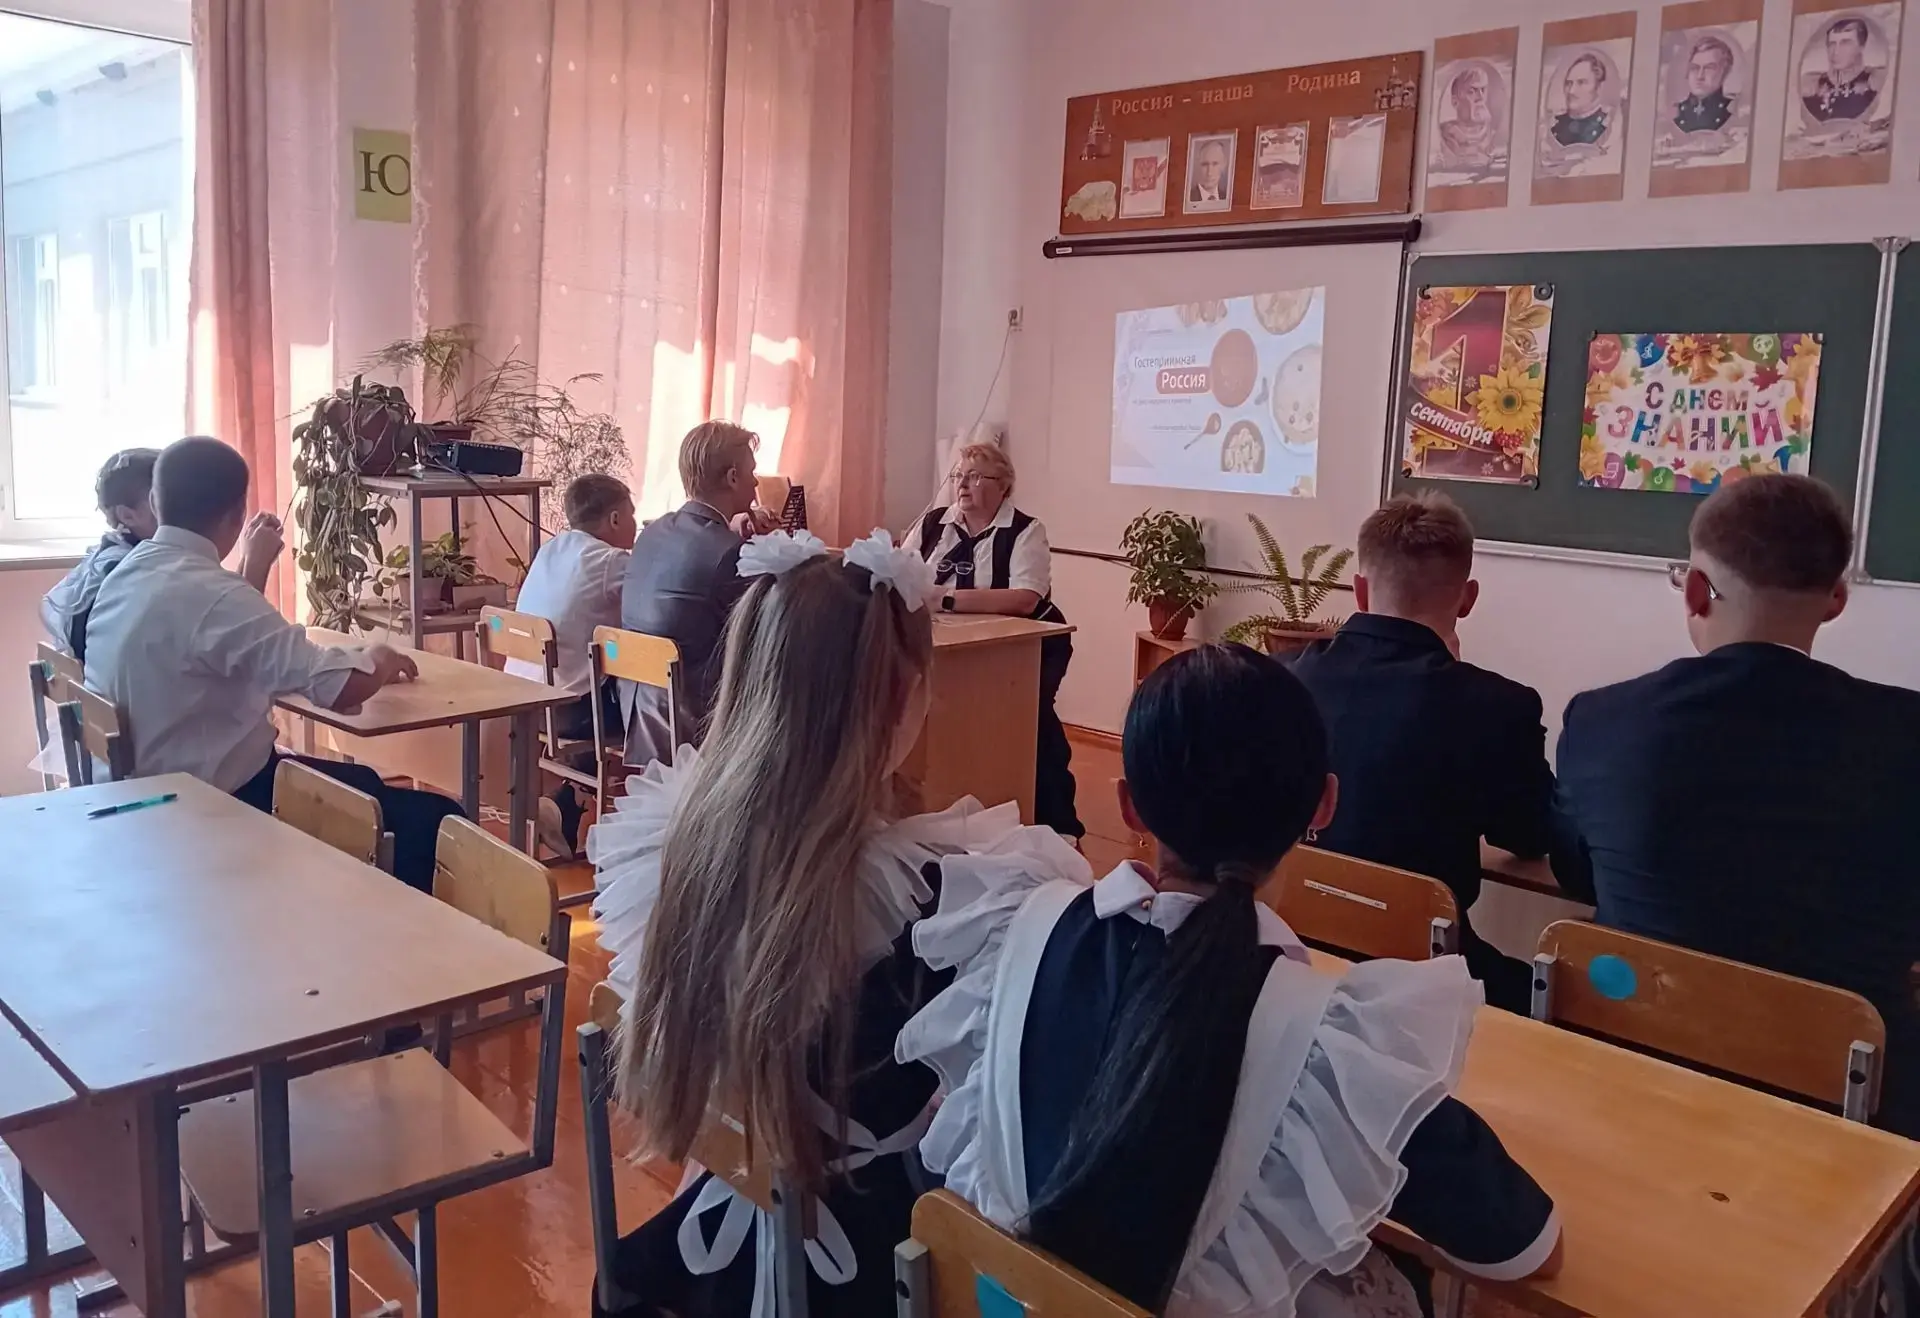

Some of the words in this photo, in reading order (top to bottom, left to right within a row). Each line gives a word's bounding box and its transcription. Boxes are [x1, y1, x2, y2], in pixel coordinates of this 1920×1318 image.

[1112, 93, 1173, 115] Россия
[1203, 84, 1253, 103] наша
[1288, 69, 1361, 94] Родина
[359, 150, 411, 196] Ю
[1134, 354, 1196, 369] Гостеприимная
[1161, 371, 1206, 389] Россия
[1645, 381, 1664, 410] С
[1410, 401, 1495, 446] сентября
[1607, 399, 1784, 452] ЗНАНИЙ
